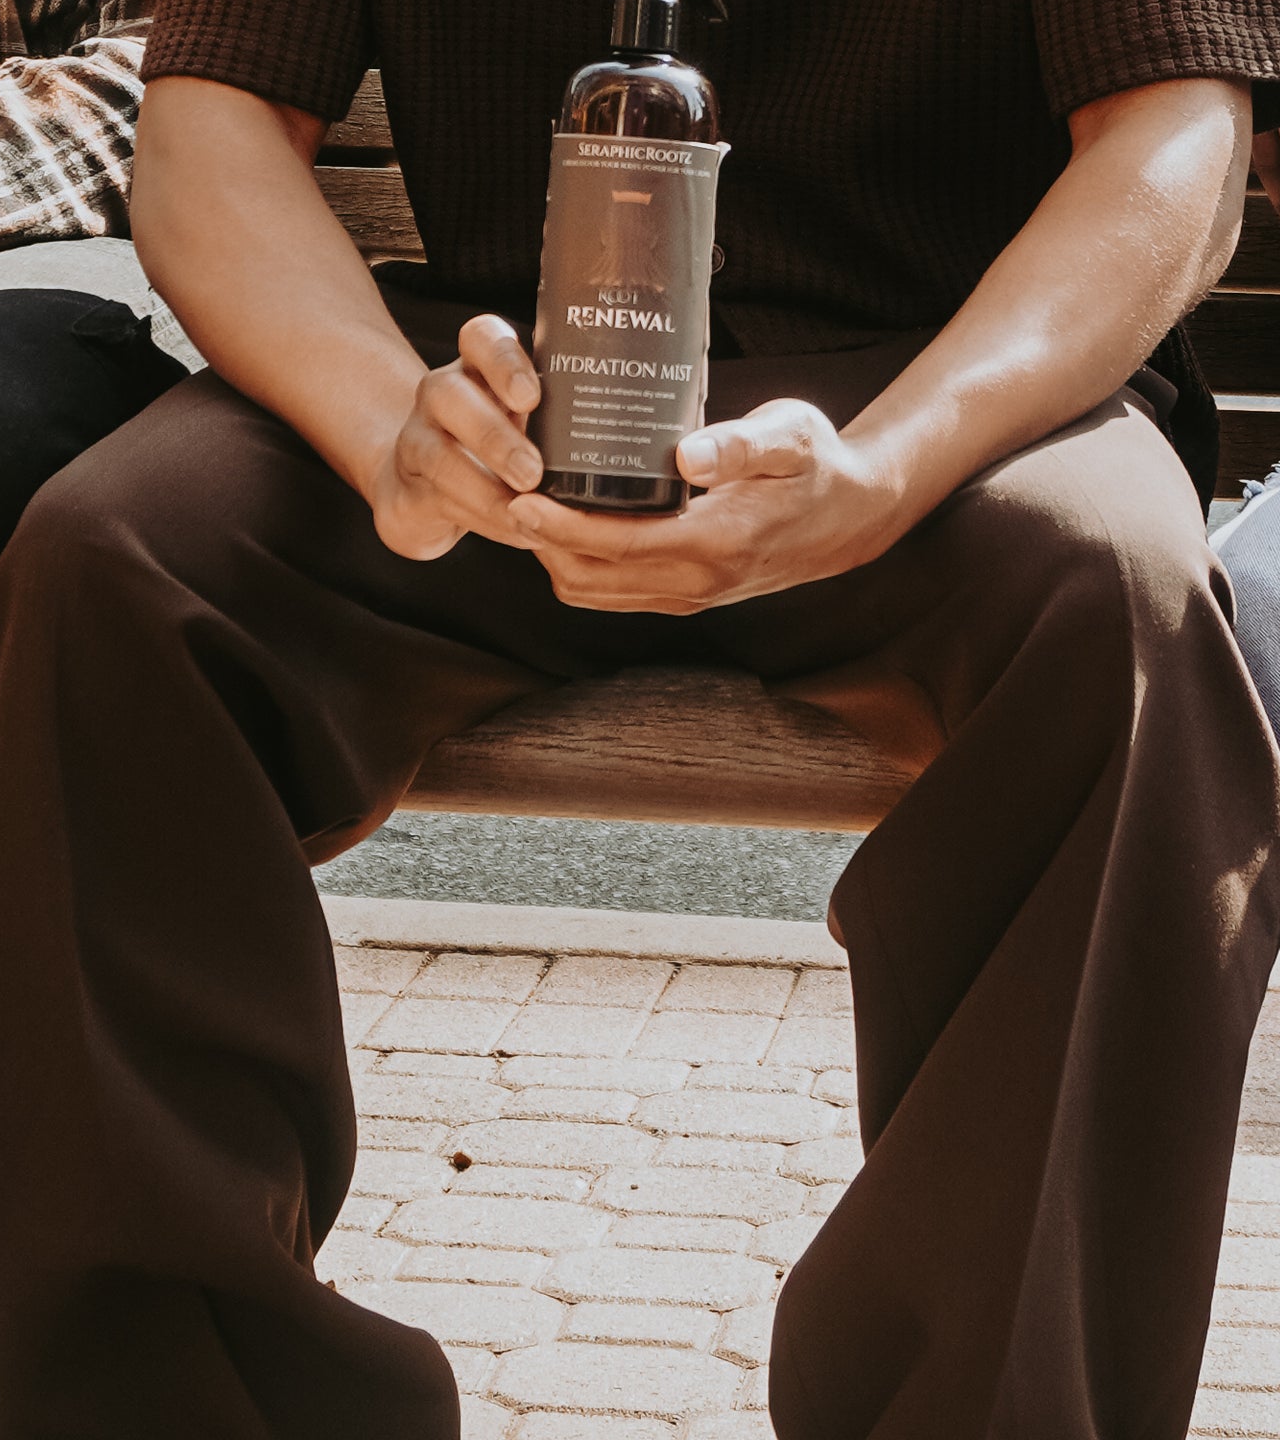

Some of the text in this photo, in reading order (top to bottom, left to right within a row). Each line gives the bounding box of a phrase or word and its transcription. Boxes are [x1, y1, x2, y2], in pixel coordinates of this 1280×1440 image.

[578, 142, 693, 165] SERAPHICROOTZ
[567, 305, 676, 333] RENEWAL
[550, 353, 693, 382] HYDRATION MIST
[570, 452, 580, 462] 16
[581, 452, 601, 466] OZ
